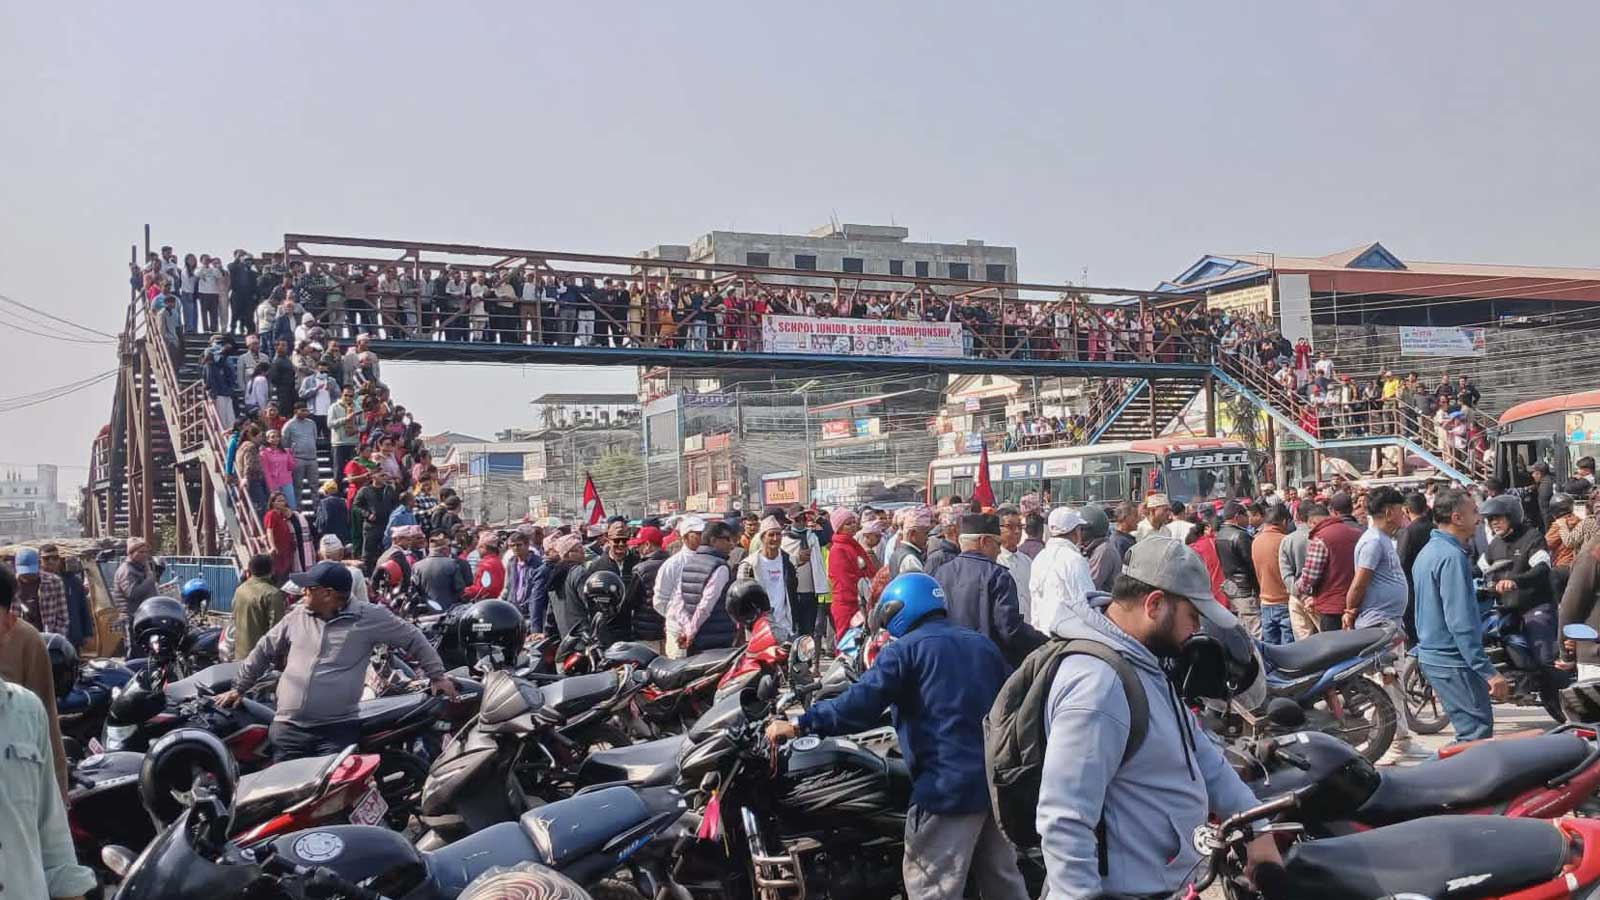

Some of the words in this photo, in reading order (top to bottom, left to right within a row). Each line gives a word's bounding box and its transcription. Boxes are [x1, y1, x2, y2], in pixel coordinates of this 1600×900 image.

[778, 321, 814, 333] SCHOOL
[816, 323, 848, 334] JUNIOR
[849, 325, 856, 334] &
[857, 324, 888, 335] SENIOR
[889, 326, 951, 338] CHAMPIONSHIP
